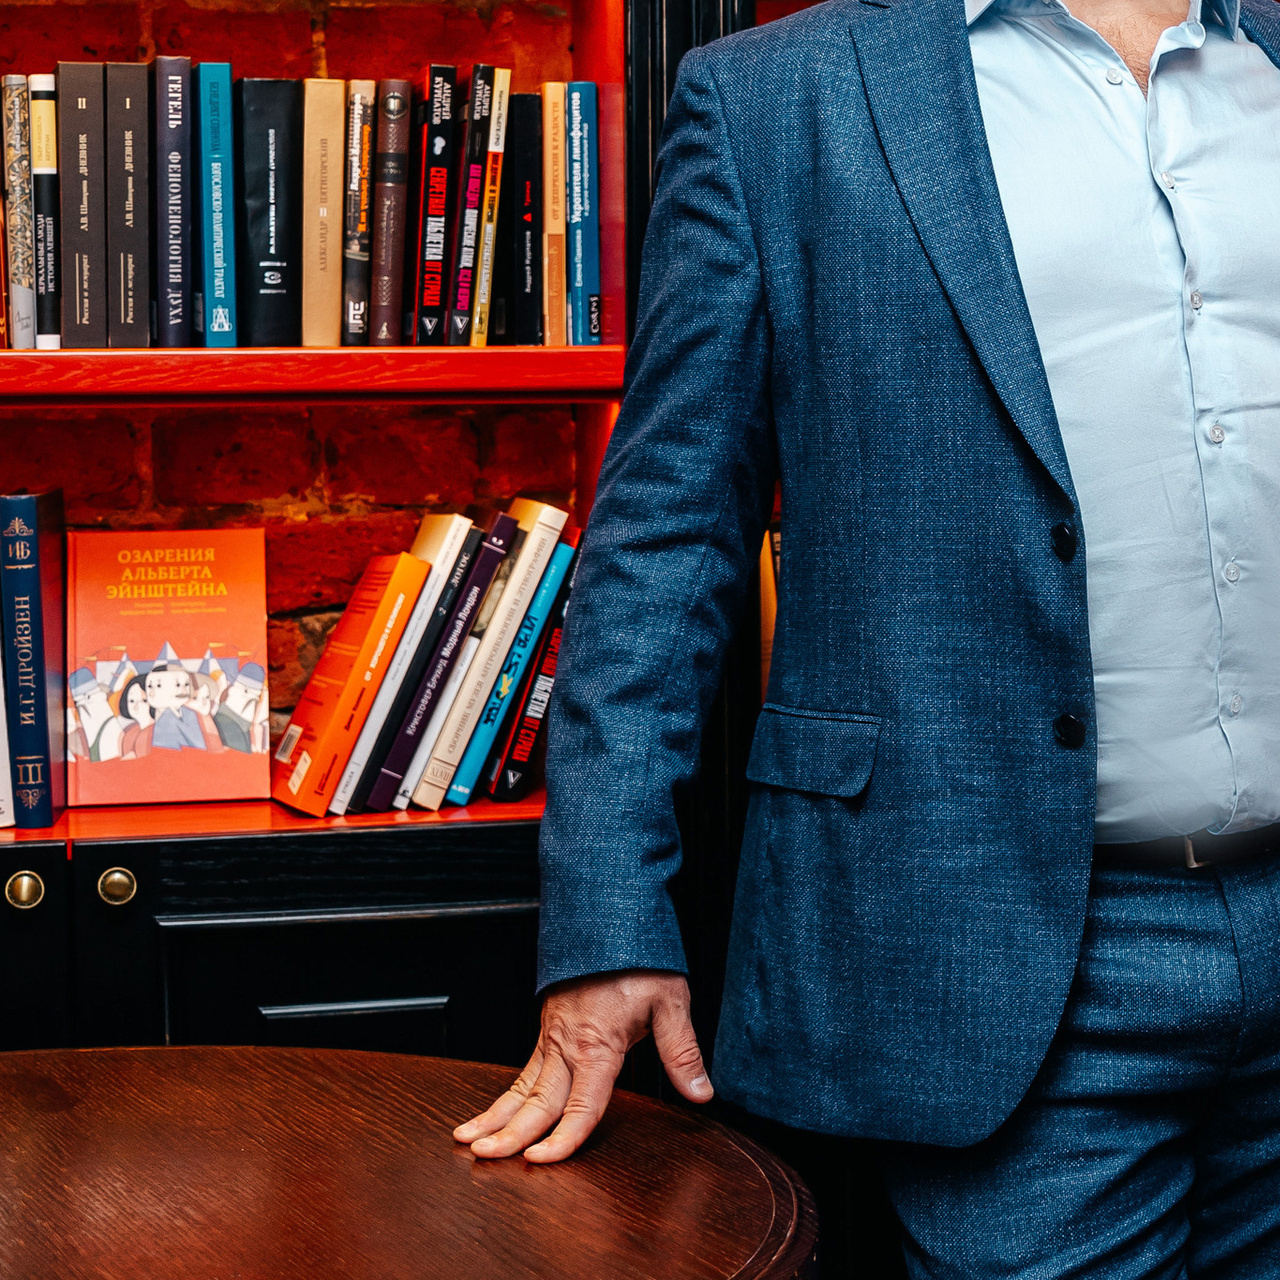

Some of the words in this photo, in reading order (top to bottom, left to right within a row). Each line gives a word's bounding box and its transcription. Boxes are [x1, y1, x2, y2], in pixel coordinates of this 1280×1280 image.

[167, 75, 182, 129] ГЕГЕЛЬ
[208, 81, 219, 117] БЕНЕДИКТ
[430, 76, 443, 125] КУРПАТОВ
[440, 82, 451, 120] АНДРЕЙ
[472, 79, 484, 120] КУРПАТОВ
[480, 84, 490, 116] АНДРЕЙ
[570, 91, 582, 160] лимфоцитов
[78, 132, 88, 176] ДНЕВНИК
[124, 129, 134, 172] ДНЕВНИК
[319, 136, 329, 203] ПЯТИГОРСКИЙ
[427, 167, 446, 215] СЕКРЕТНАЯ
[571, 161, 583, 223] Укротители
[36, 212, 45, 238] ЛЮДИ
[45, 215, 55, 250] ЛЕВШЕЙ
[167, 151, 182, 283] ФЕНОМЕНОЛОГИЯ
[210, 162, 226, 267] БОГОСЛОВСКО-ПОЛИТИЧЕСКИЙ
[319, 220, 328, 272] АЛЕКСАНДР
[423, 216, 444, 260] ТАБЛЕТКА
[524, 229, 533, 264] Курпатов
[575, 228, 583, 262] Павлова
[37, 238, 46, 294] ЗЕРКАЛЬНЫЕ
[47, 251, 56, 291] ИСТОРИЯ
[212, 268, 224, 298] ТРАКТАТ
[423, 261, 441, 273] ОТ
[524, 265, 533, 292] Андрей
[575, 263, 583, 286] Елена
[166, 288, 182, 326] ДУХА
[421, 274, 440, 307] СТРАХА
[117, 547, 215, 564] ОЗАРЕНИЯ
[121, 565, 213, 581] АЛЬБЕРТА
[106, 580, 228, 599] ЭЙНШТЕЙНА
[385, 591, 406, 628] ВЕЛИКОМУ
[14, 594, 36, 687] ДРОЙЗЕН
[366, 632, 390, 668] ХОРОШЕГО
[363, 670, 374, 680] ОТ
[19, 692, 36, 725] И.Г.
